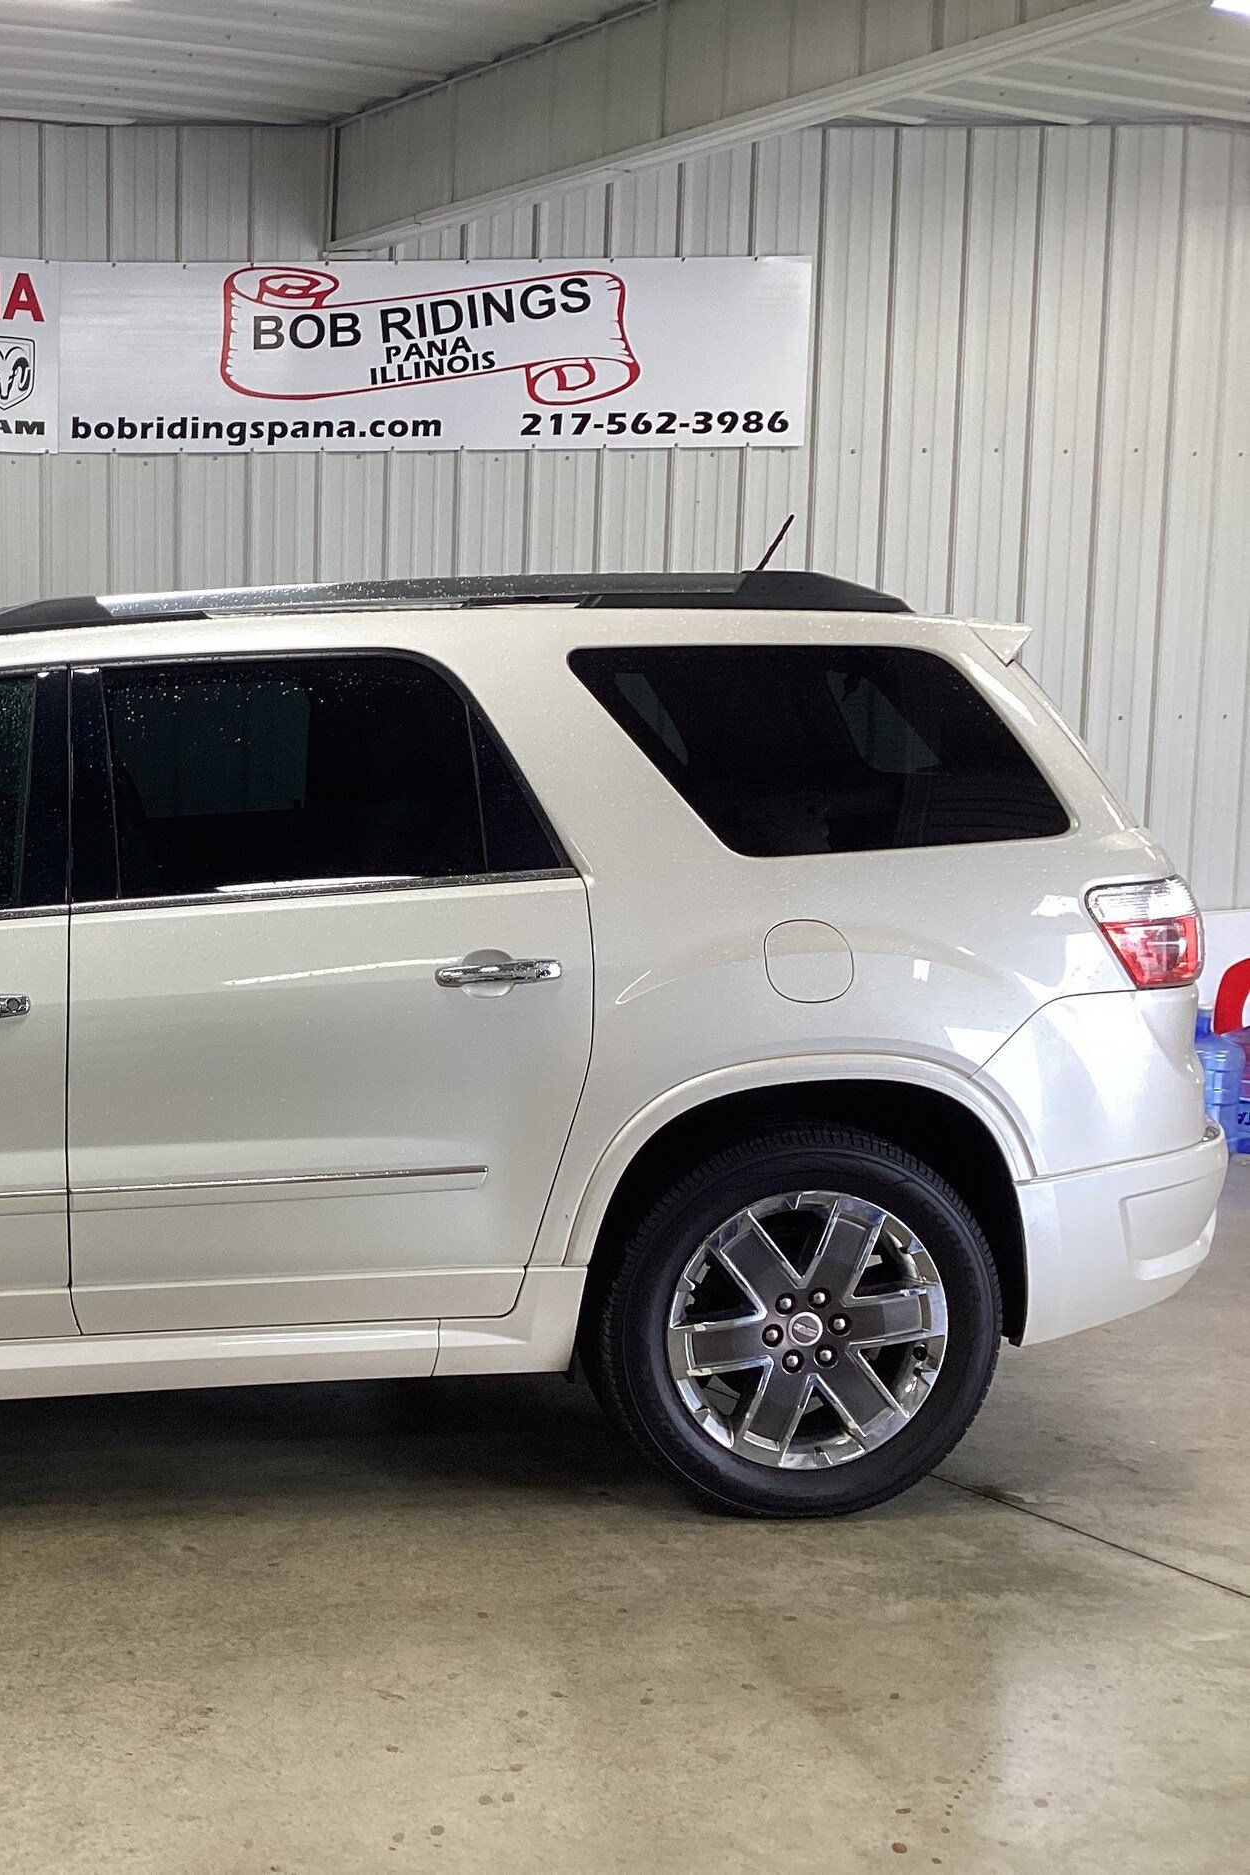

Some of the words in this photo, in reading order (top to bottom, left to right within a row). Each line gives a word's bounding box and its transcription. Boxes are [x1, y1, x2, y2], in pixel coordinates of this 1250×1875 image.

[253, 311, 363, 351] BOB
[378, 277, 594, 345] RIDINGS
[385, 335, 473, 365] PANA
[370, 350, 497, 386] ILLINOIS
[71, 416, 442, 446] bobridingspana.com
[520, 410, 790, 436] 217-562-3986
